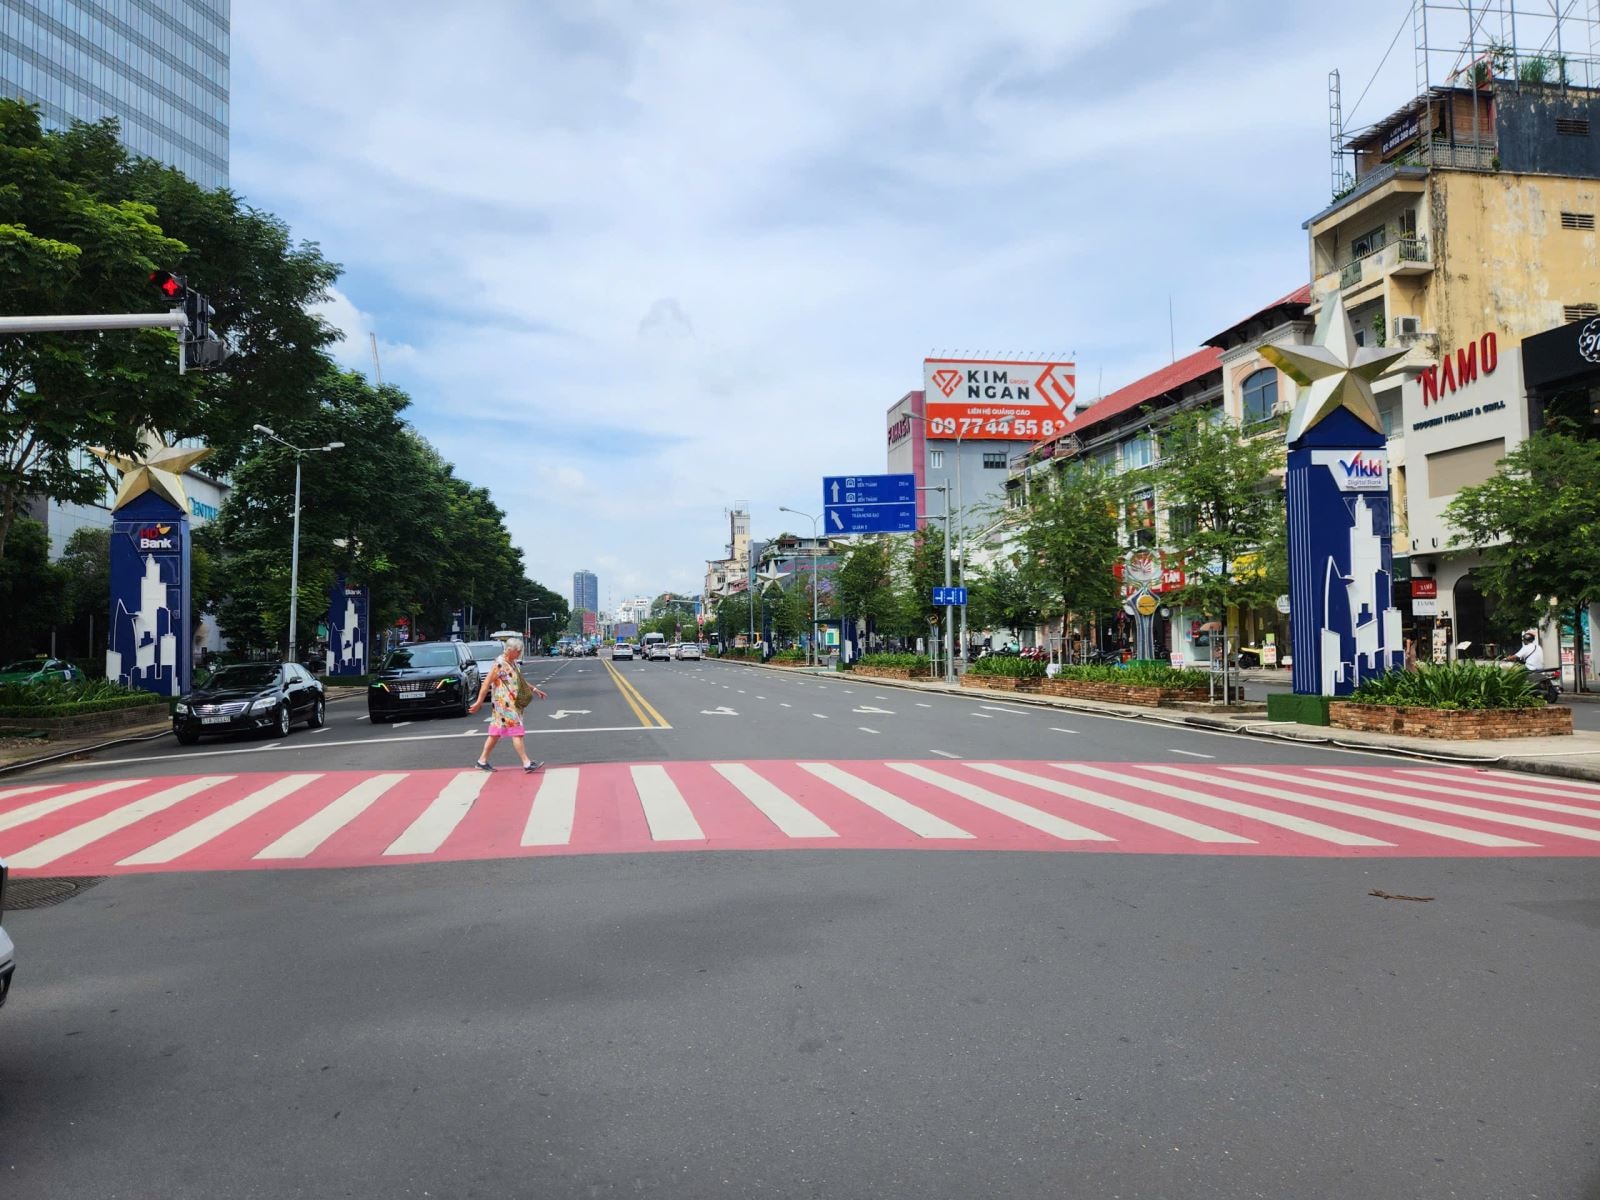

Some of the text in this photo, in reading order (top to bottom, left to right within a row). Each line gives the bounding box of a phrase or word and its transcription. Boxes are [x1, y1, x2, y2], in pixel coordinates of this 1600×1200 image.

[968, 370, 1008, 384] KIM
[1416, 332, 1497, 407] NAMO
[968, 386, 1030, 400] NGAN
[931, 418, 956, 435] 09
[959, 418, 984, 435] 77
[985, 419, 1010, 436] 44
[1014, 420, 1038, 436] 55
[1339, 450, 1383, 477] Vikki
[140, 538, 172, 549] Bank
